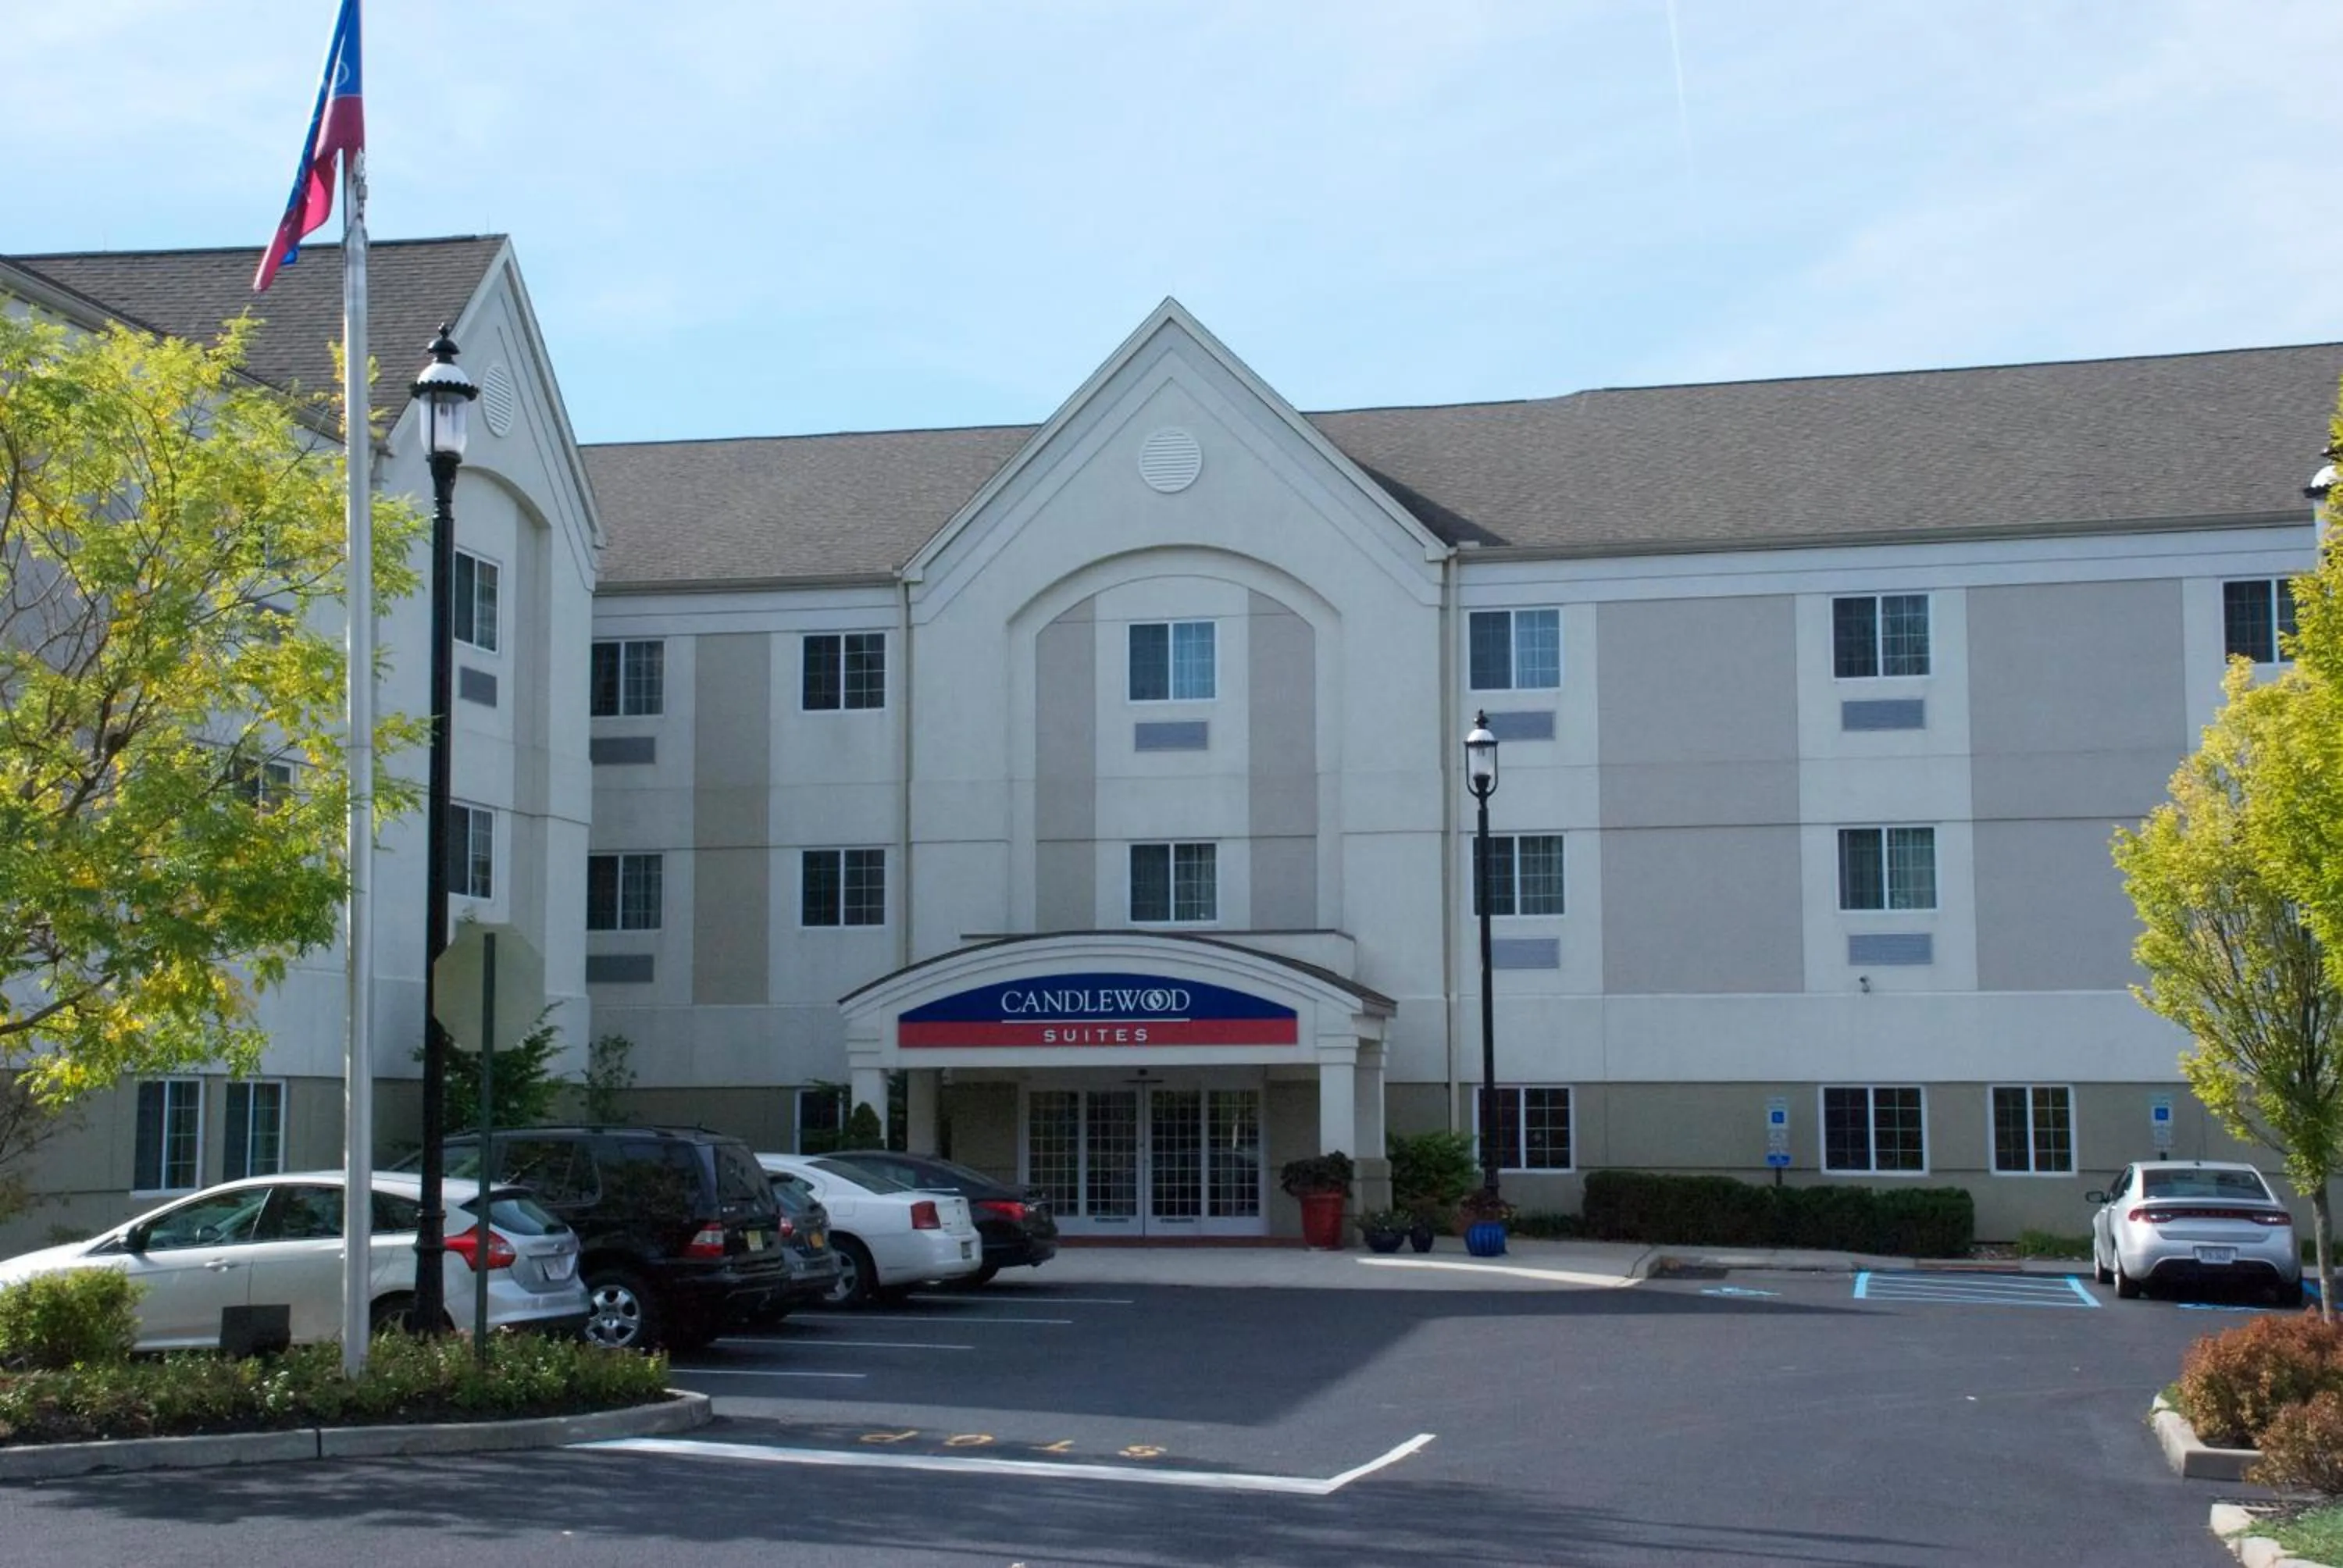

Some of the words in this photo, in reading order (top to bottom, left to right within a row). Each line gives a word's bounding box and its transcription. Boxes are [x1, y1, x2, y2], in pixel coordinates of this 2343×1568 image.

[1001, 989, 1191, 1013] CANDLEWOOD
[1043, 1028, 1148, 1042] SUITES
[860, 1431, 1166, 1457] STOP
